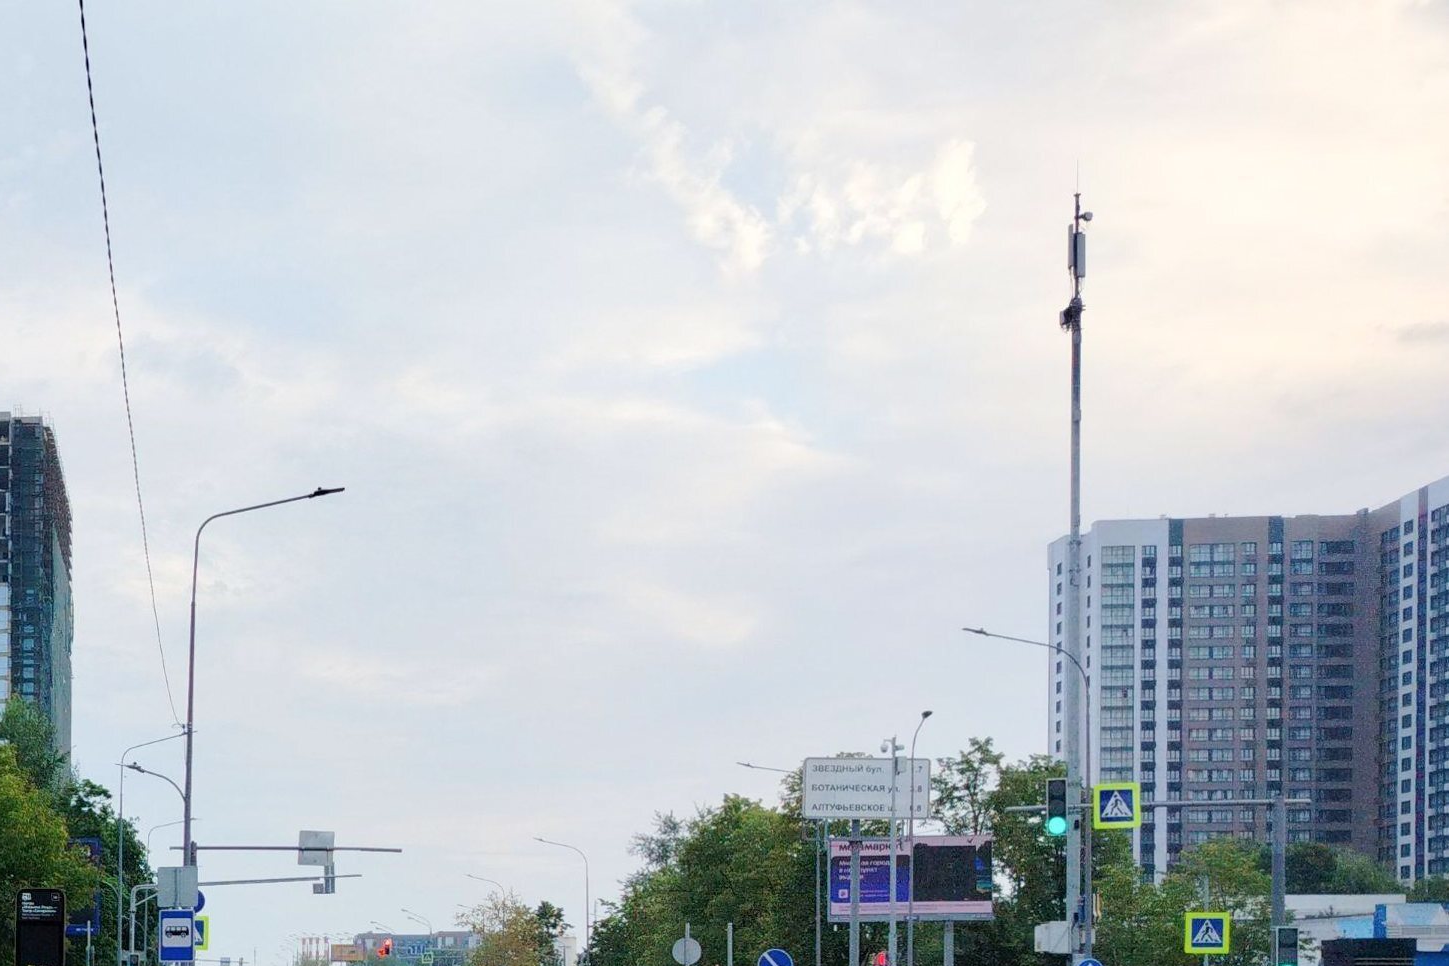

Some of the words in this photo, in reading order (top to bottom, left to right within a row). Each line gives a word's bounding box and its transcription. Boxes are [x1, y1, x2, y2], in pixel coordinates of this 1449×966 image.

[812, 764, 863, 773] ЗВЕЗДНЫЙ
[865, 765, 885, 774] бул.
[811, 784, 885, 793] БОТАНИЧЕСКАЯ
[812, 803, 885, 812] АЛТУФЬЕВСКОЕ
